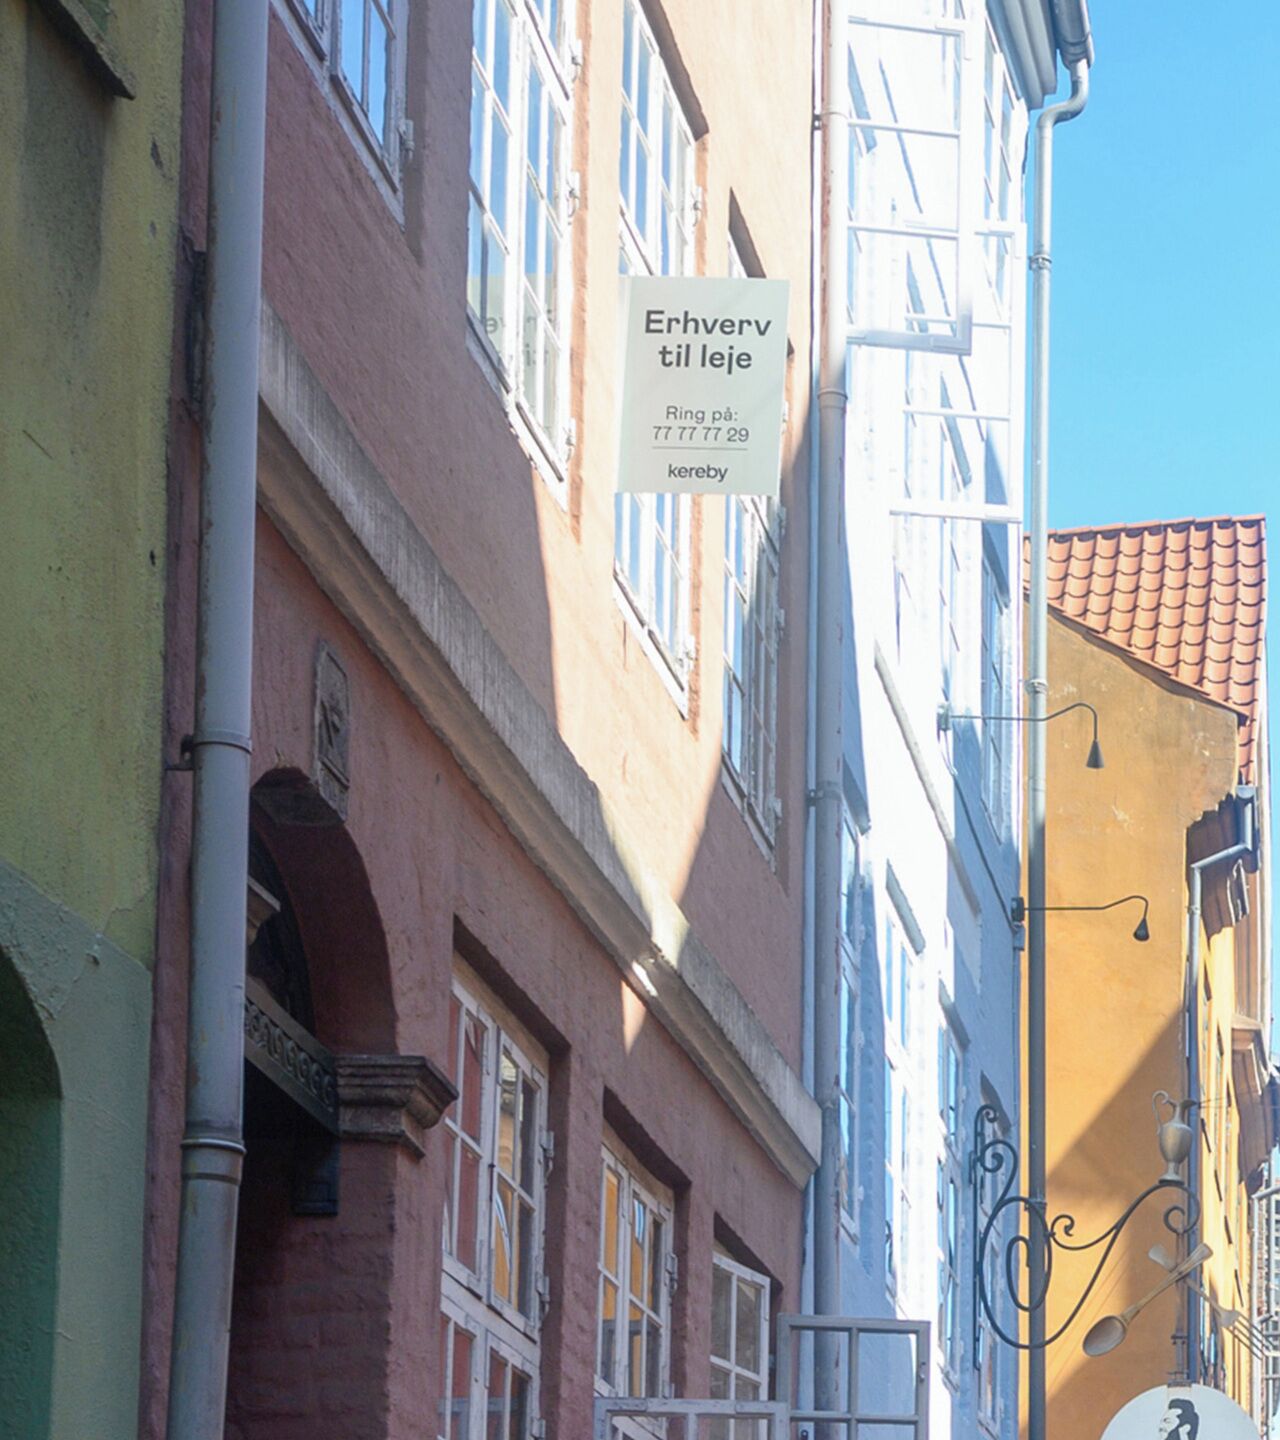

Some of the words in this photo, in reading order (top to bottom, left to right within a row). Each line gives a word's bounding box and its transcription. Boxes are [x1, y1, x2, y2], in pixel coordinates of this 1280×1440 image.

[644, 309, 772, 336] Erhverv
[658, 343, 691, 368] til
[700, 344, 753, 375] leje
[665, 405, 706, 424] Ring
[711, 406, 739, 424] på:
[652, 425, 673, 442] 77
[677, 425, 698, 442] 77
[702, 426, 722, 442] 77
[726, 427, 750, 443] 29
[667, 463, 729, 482] kereby
